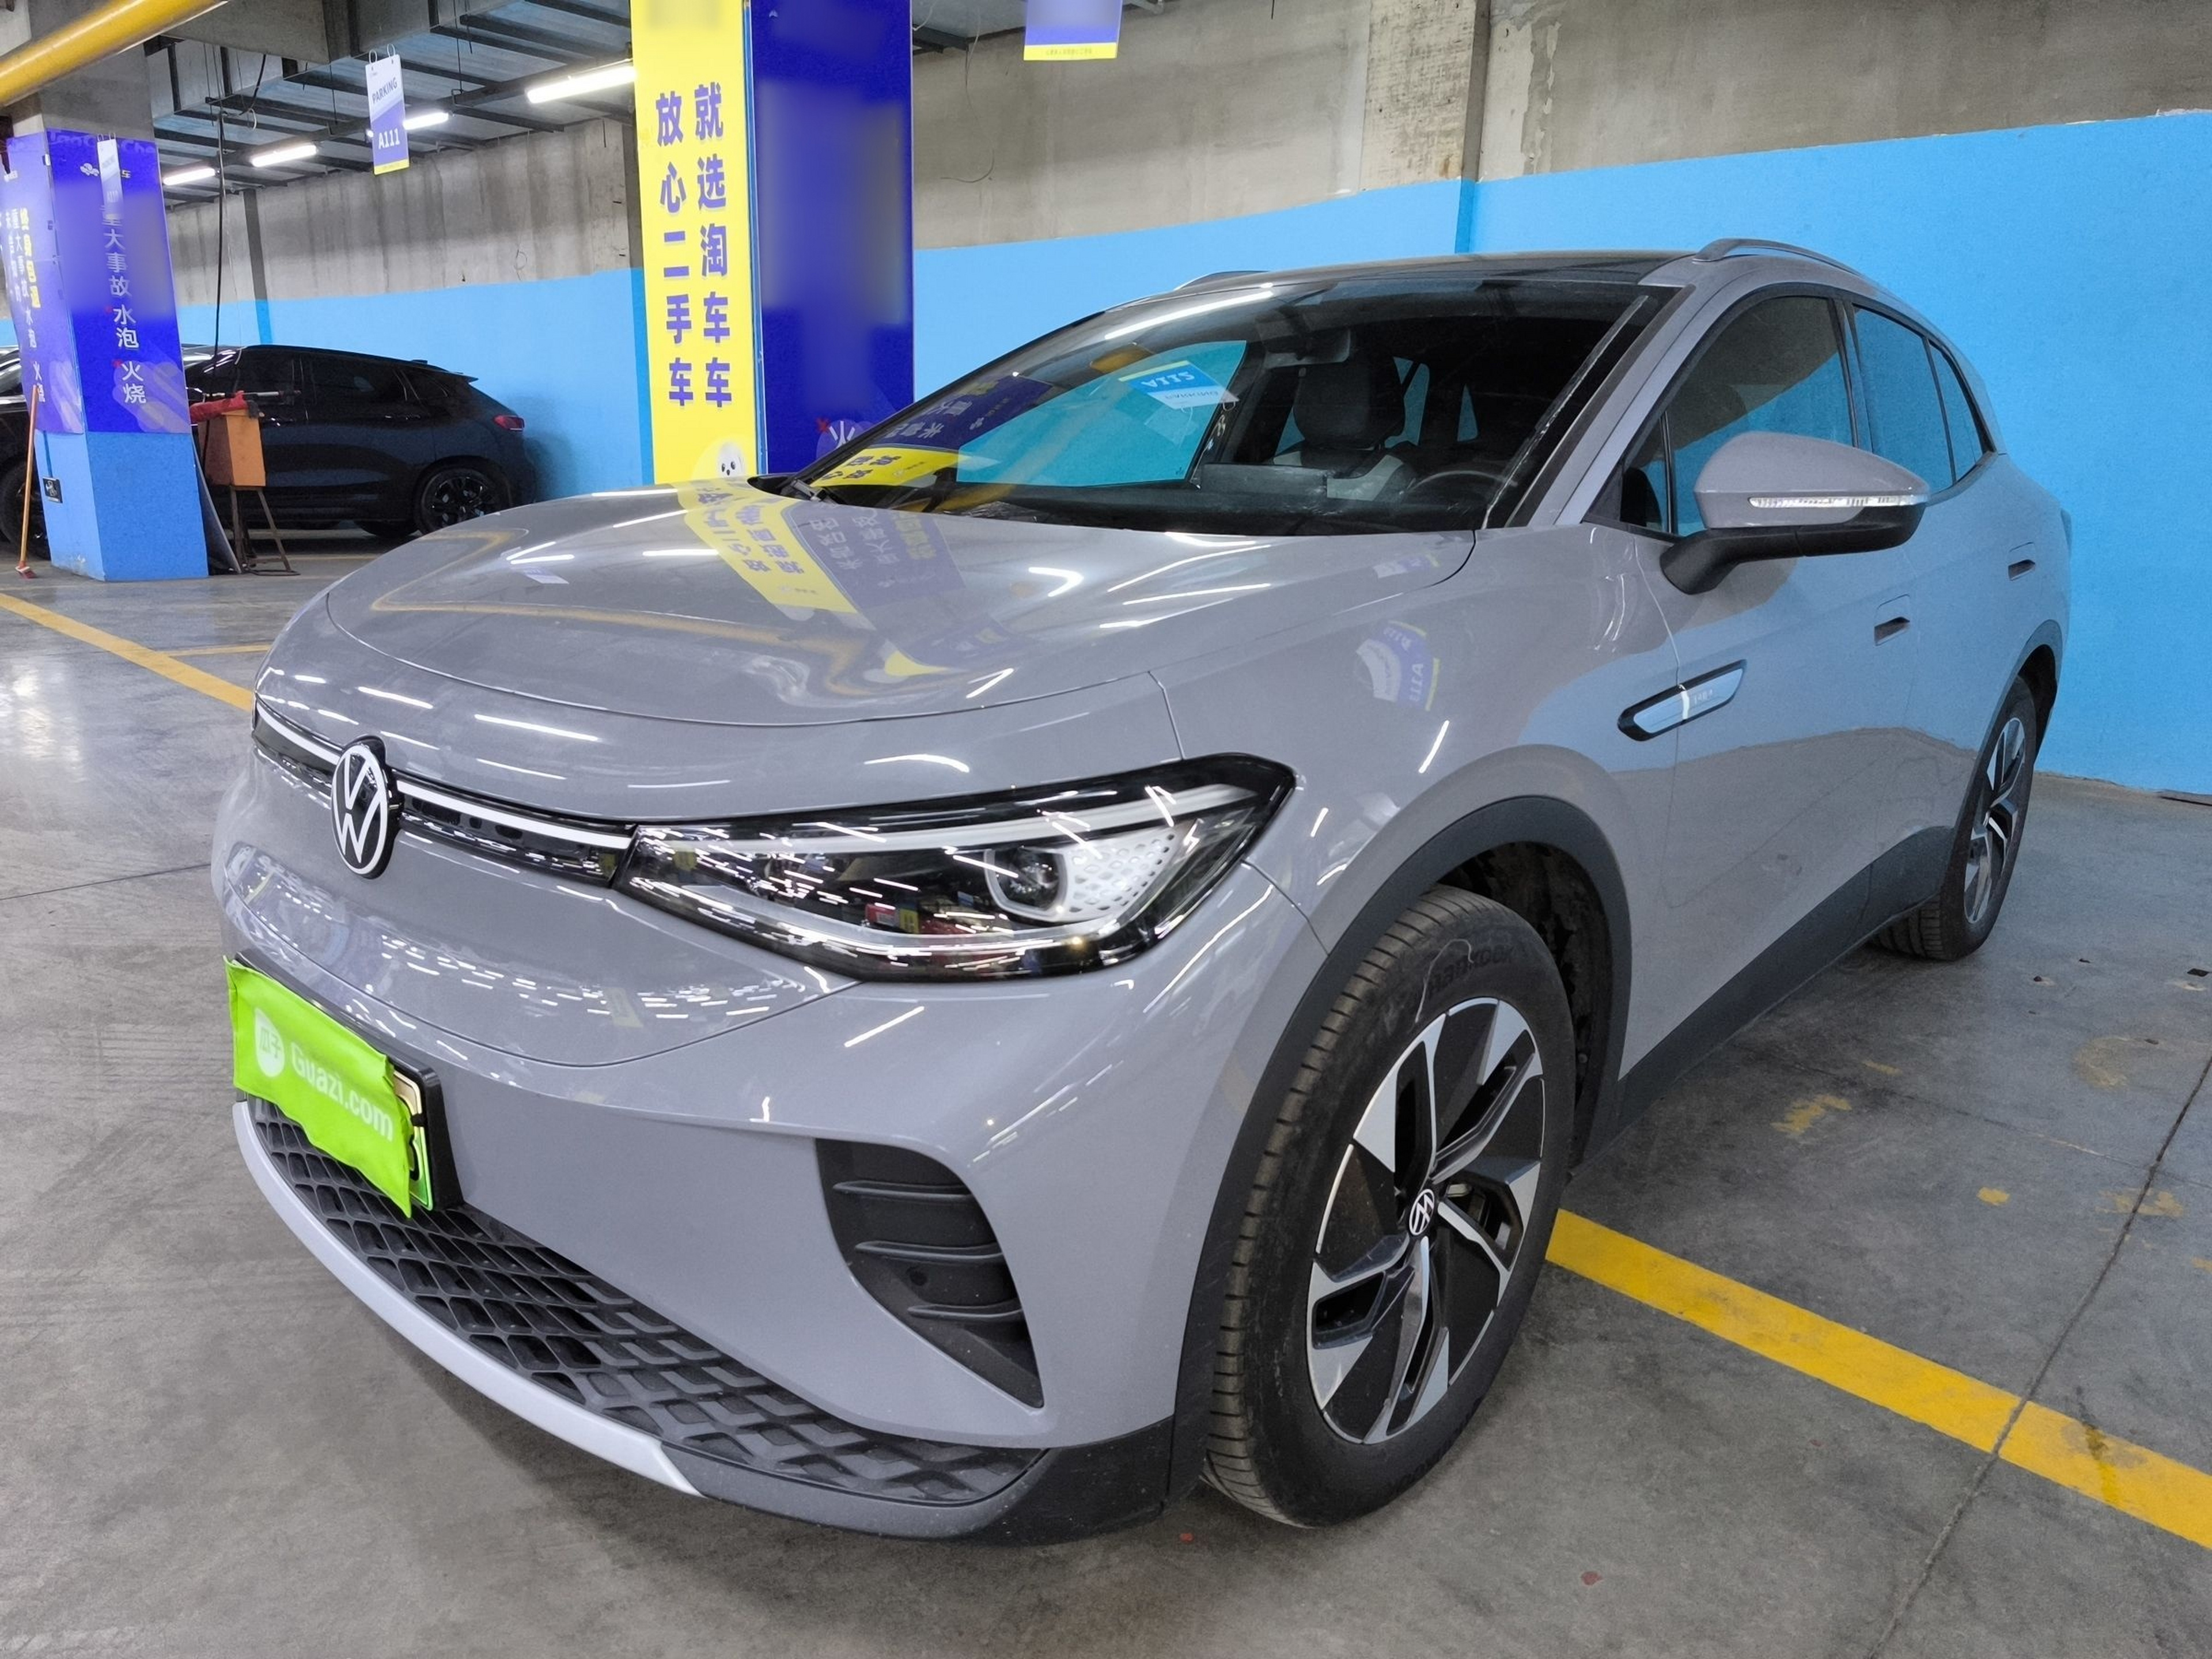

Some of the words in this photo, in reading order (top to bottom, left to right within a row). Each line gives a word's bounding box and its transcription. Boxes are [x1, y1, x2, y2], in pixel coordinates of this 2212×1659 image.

[372, 77, 398, 103] PARKING
[378, 127, 400, 150] A111
[656, 90, 694, 407] 放心二手车
[694, 81, 732, 408] 就选淘车车
[113, 304, 139, 349] 水泡
[122, 360, 147, 404] 火烧
[291, 1041, 393, 1142] Guazi.com
